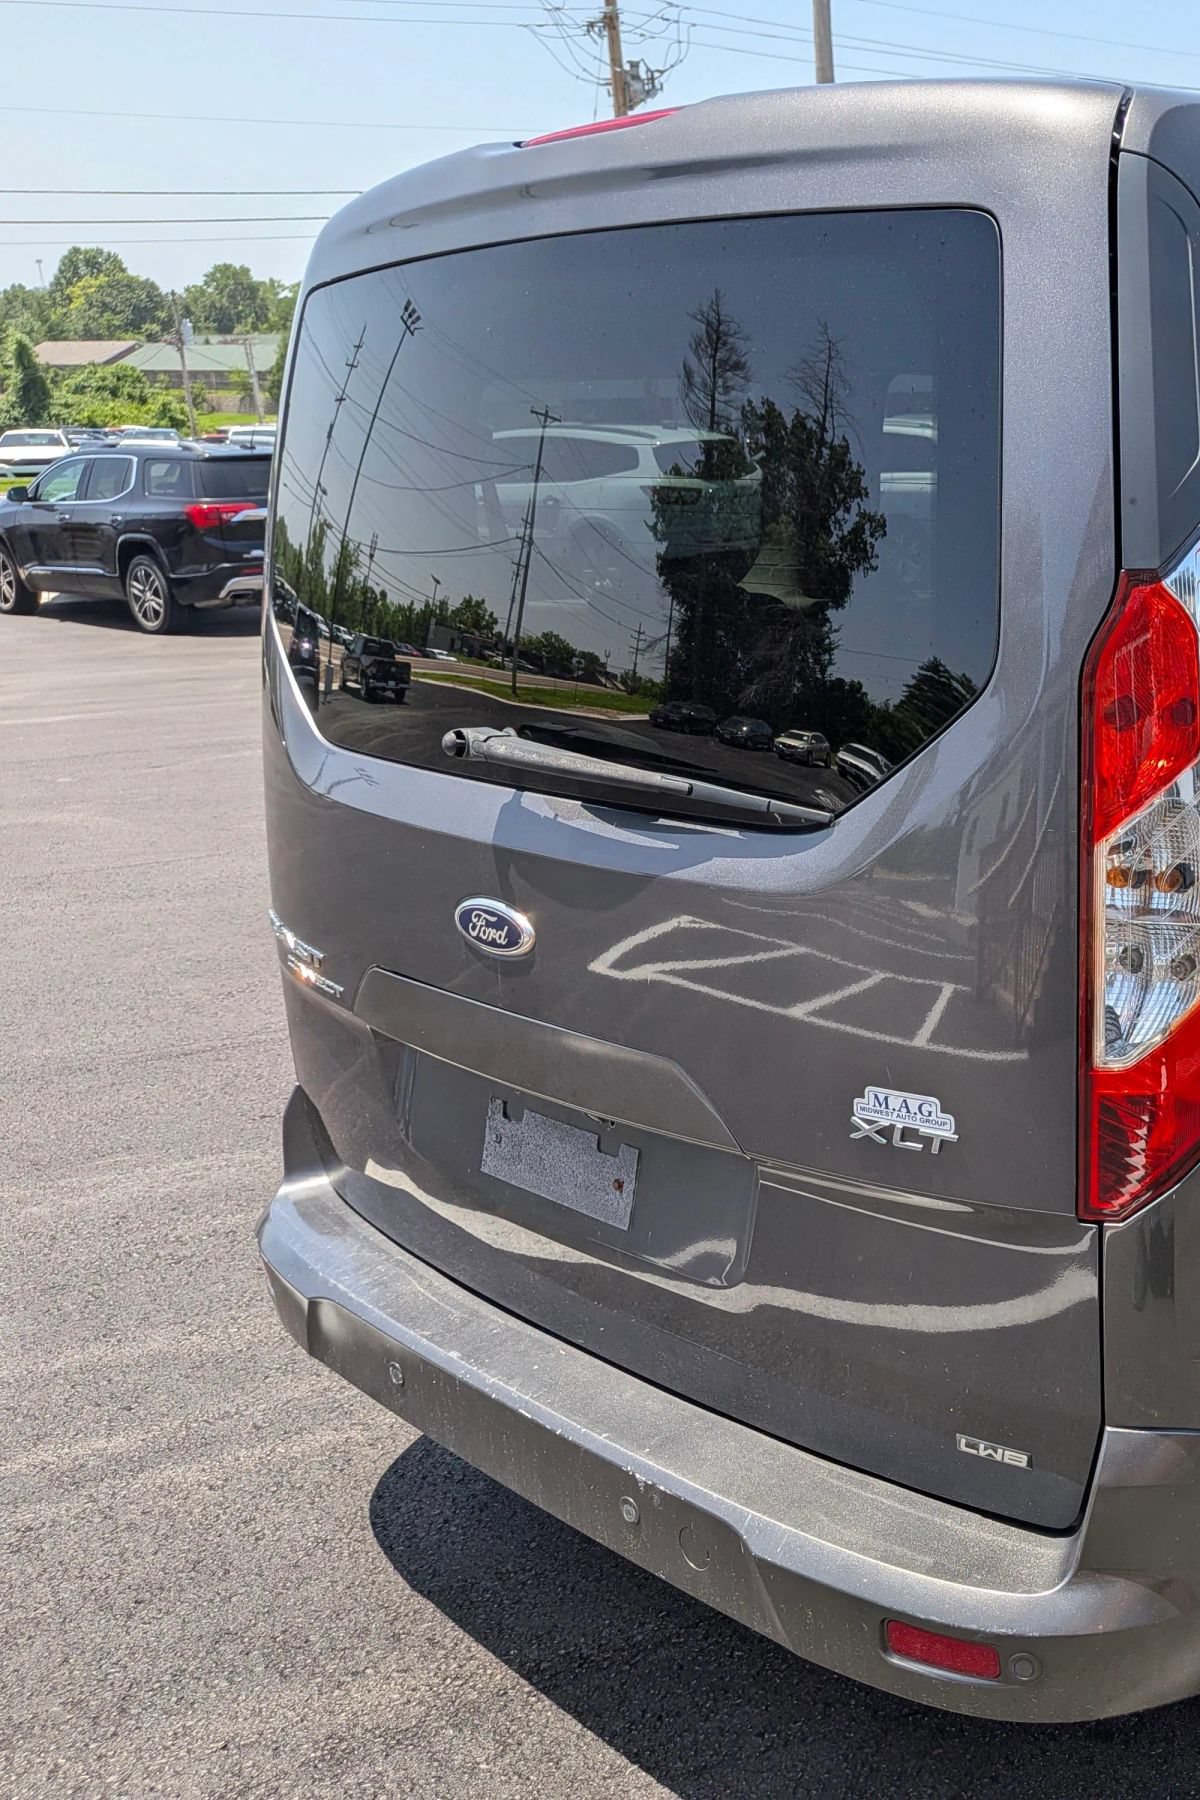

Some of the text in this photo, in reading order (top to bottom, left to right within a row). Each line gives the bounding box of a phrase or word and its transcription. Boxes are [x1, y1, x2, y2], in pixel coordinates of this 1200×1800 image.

[469, 911, 508, 945] Ford
[859, 1105, 948, 1128] MIDWEST AUTO GROUP
[848, 1116, 959, 1155] XLT
[960, 1438, 1028, 1467] LWB
